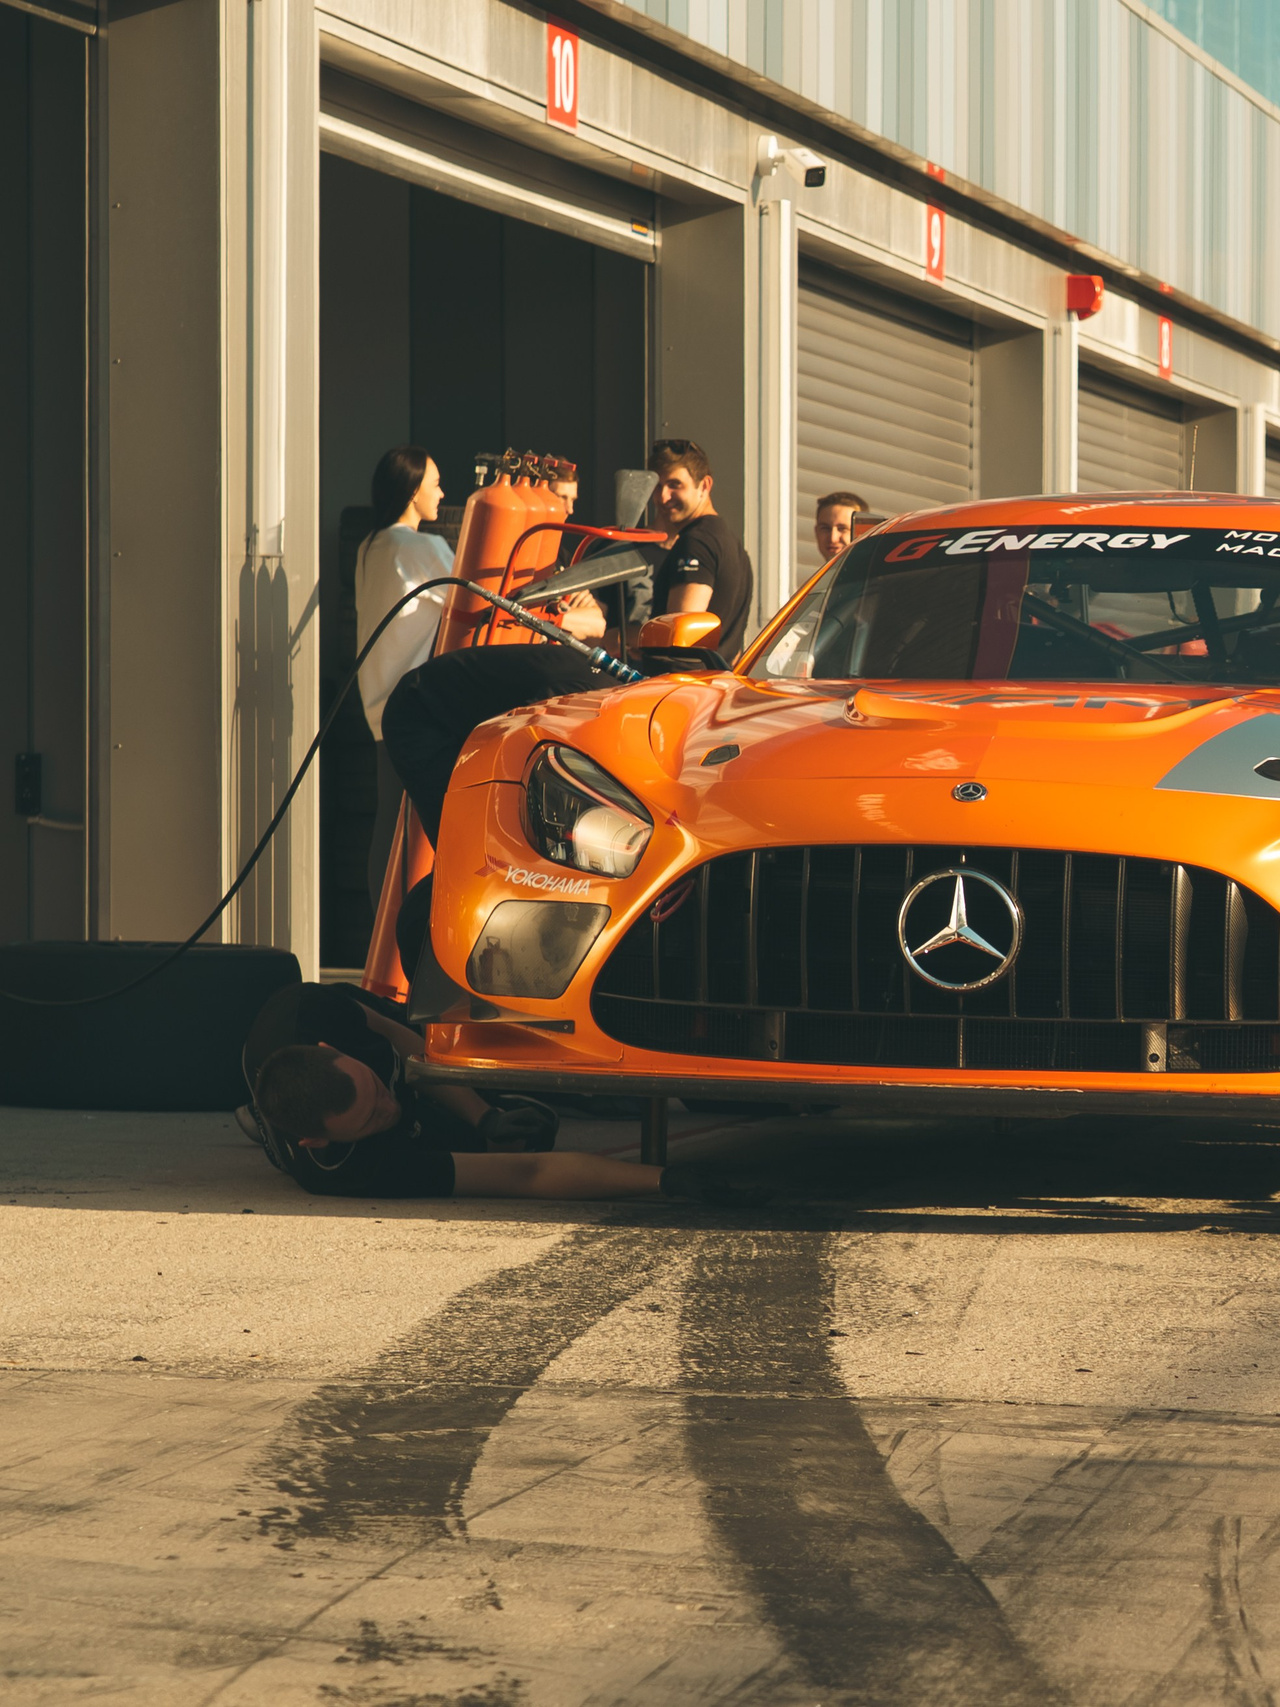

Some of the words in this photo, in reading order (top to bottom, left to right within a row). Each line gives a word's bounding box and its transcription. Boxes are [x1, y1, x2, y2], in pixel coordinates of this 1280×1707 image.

[552, 35, 574, 113] 10
[931, 213, 941, 269] 9
[1161, 321, 1170, 369] 8
[504, 865, 592, 896] YOKOHAMA
